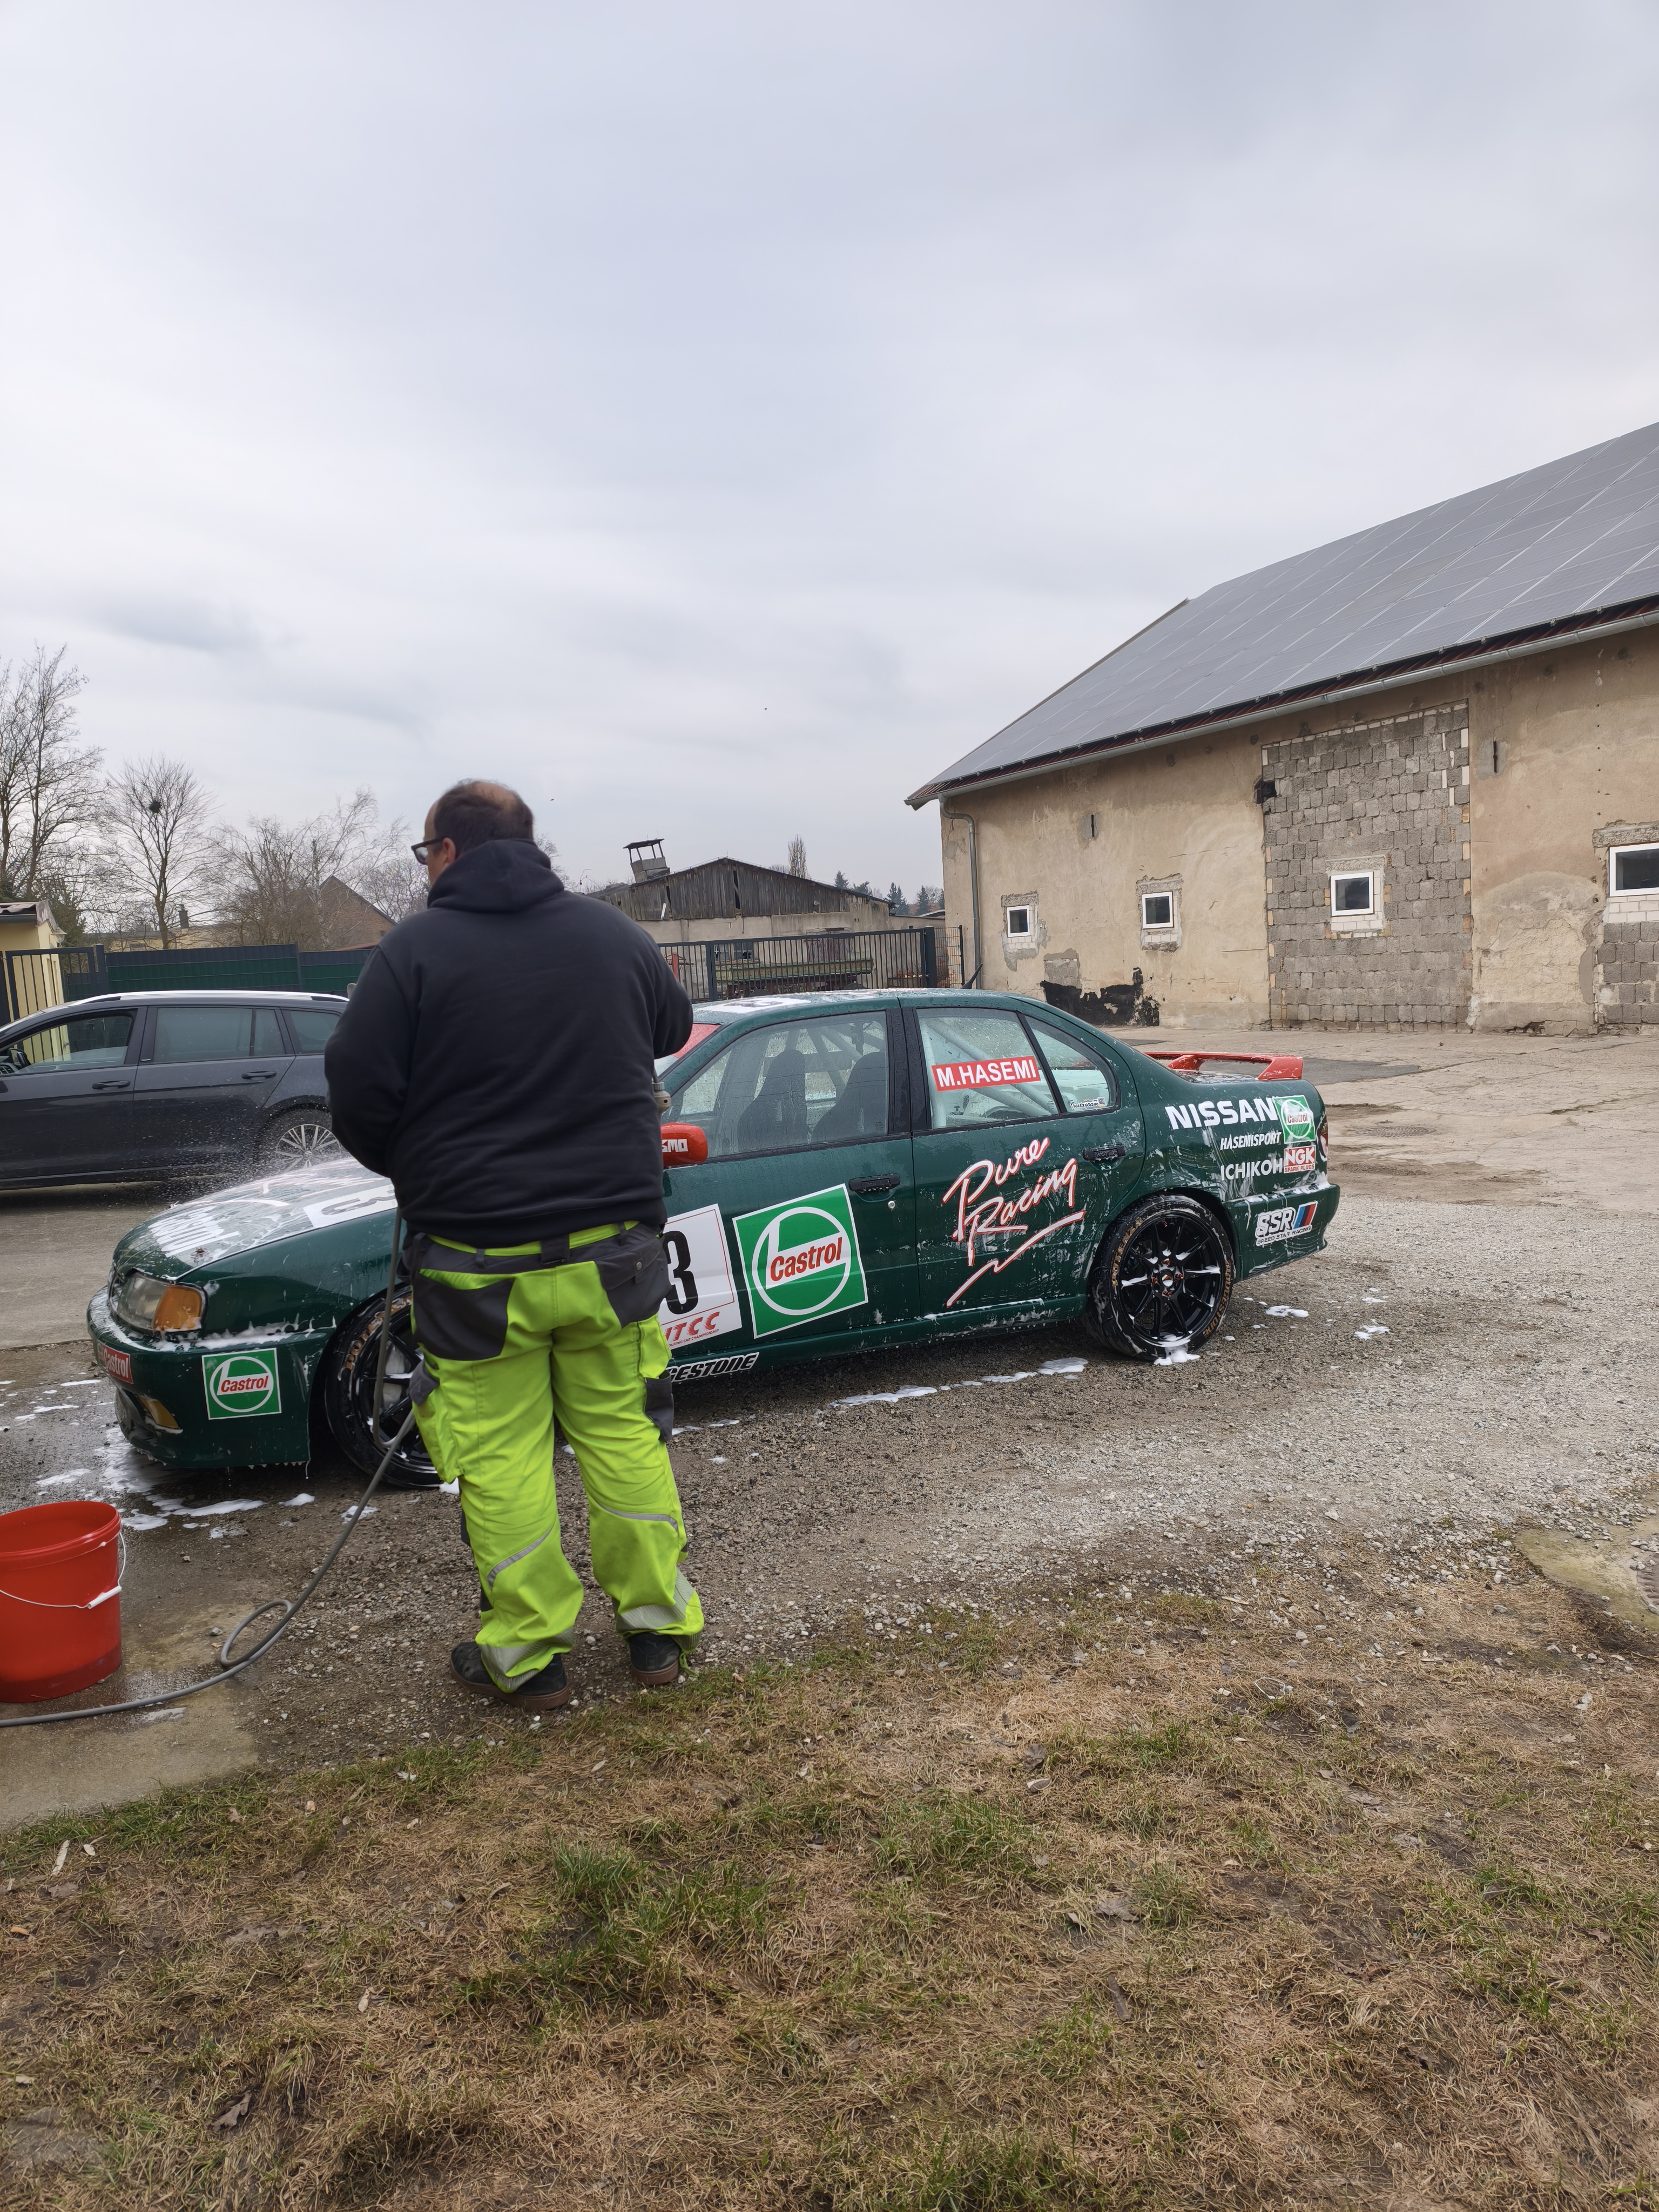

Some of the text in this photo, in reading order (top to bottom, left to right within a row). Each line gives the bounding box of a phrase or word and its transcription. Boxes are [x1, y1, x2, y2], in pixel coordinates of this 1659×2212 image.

[935, 1059, 1037, 1087] M.HASEMI
[1164, 1097, 1278, 1130] NISSAN
[1219, 1131, 1282, 1150] HASEMISPORT
[1220, 1158, 1283, 1181] ICHIKOH
[1285, 1146, 1315, 1166] NGK
[941, 1136, 1050, 1244] Pure
[963, 1158, 1078, 1267] Racing
[1256, 1209, 1294, 1237] SSR
[1257, 1236, 1275, 1245] SPEED
[1292, 1226, 1311, 1235] RACING
[663, 1230, 699, 1315] 3
[770, 1236, 842, 1282] Castrol
[103, 1347, 129, 1378] Castrol
[220, 1375, 269, 1393] Castrol
